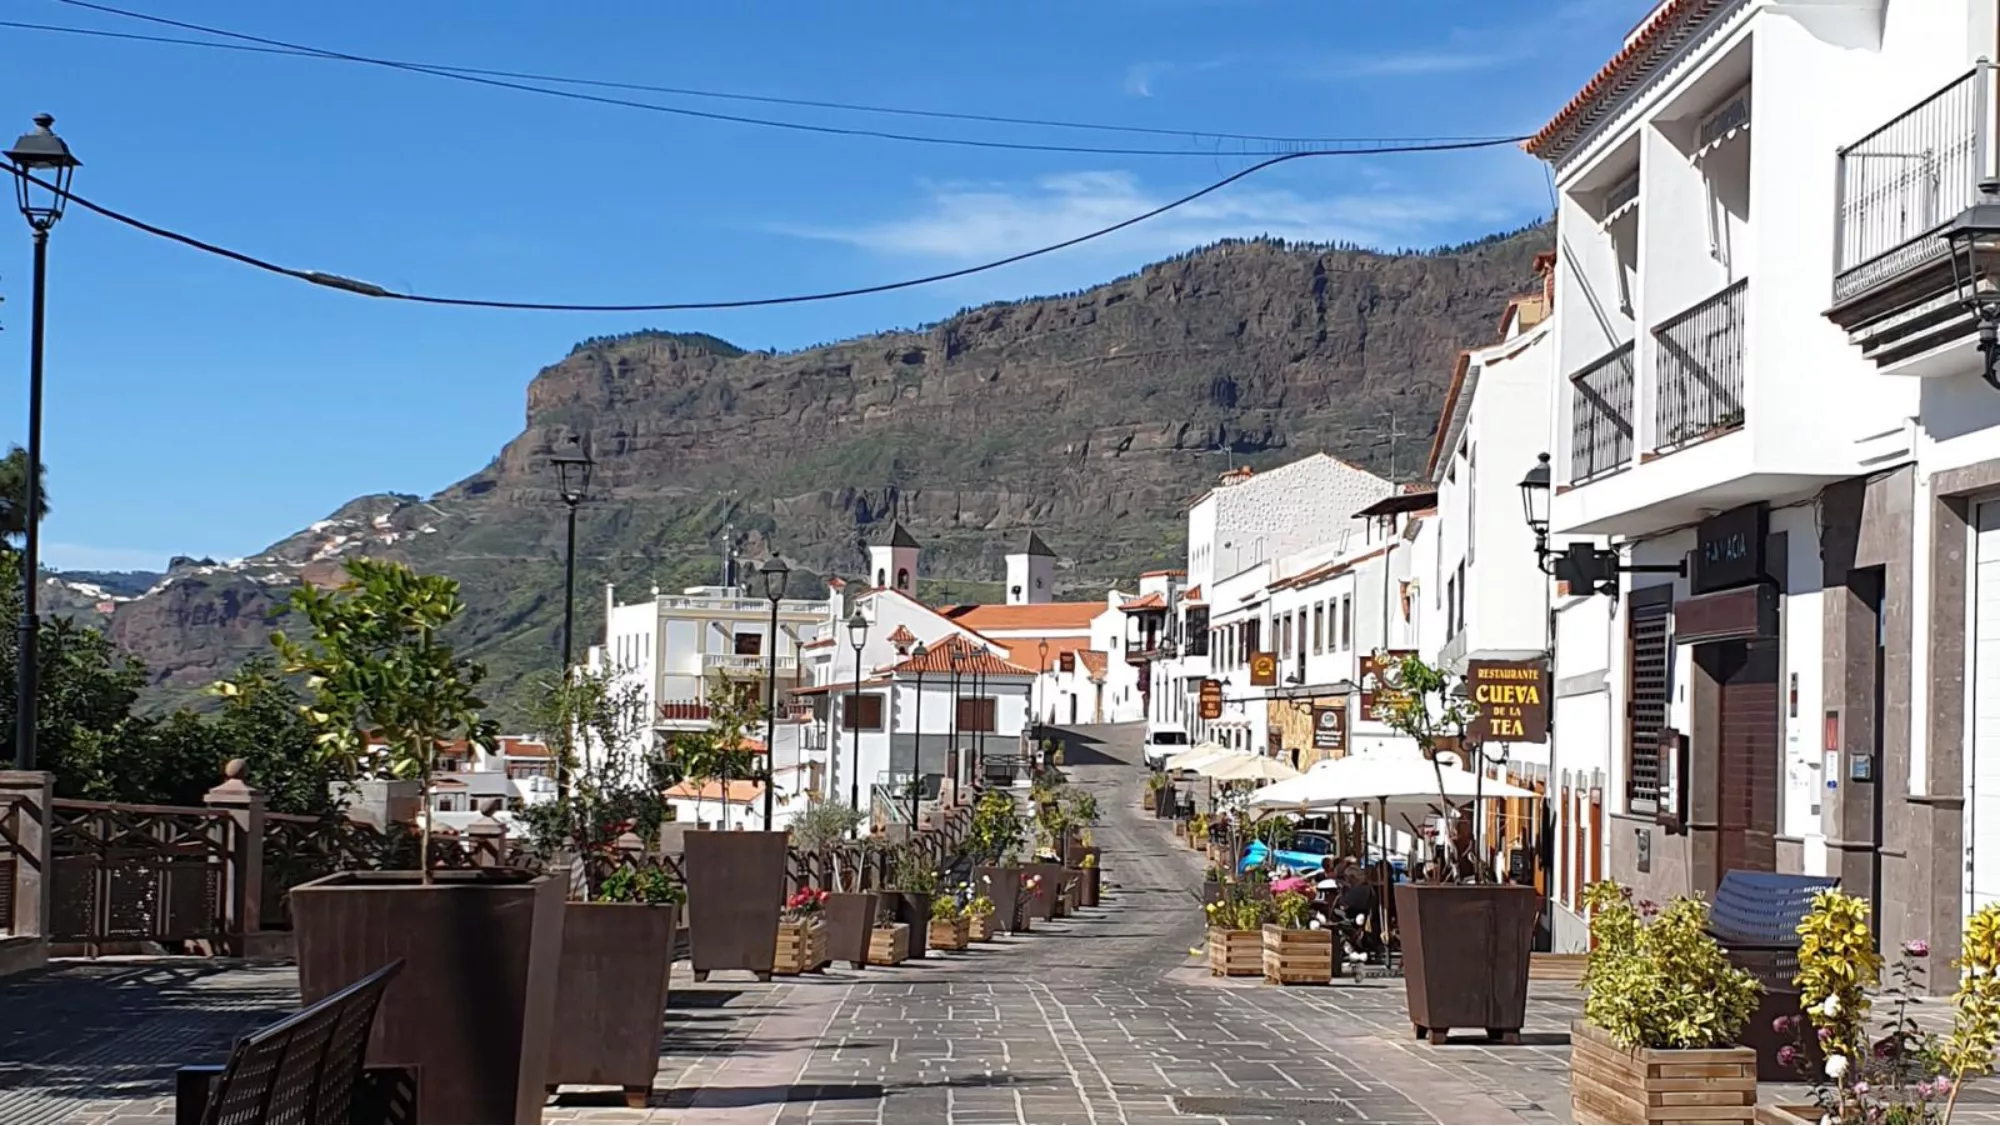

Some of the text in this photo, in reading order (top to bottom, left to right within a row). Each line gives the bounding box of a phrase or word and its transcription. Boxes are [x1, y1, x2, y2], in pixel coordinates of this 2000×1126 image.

[1477, 668, 1539, 680] RESTAURANTE
[1475, 684, 1540, 704] CUEVA
[1493, 706, 1522, 717] DE LA
[1490, 719, 1524, 736] TEA
